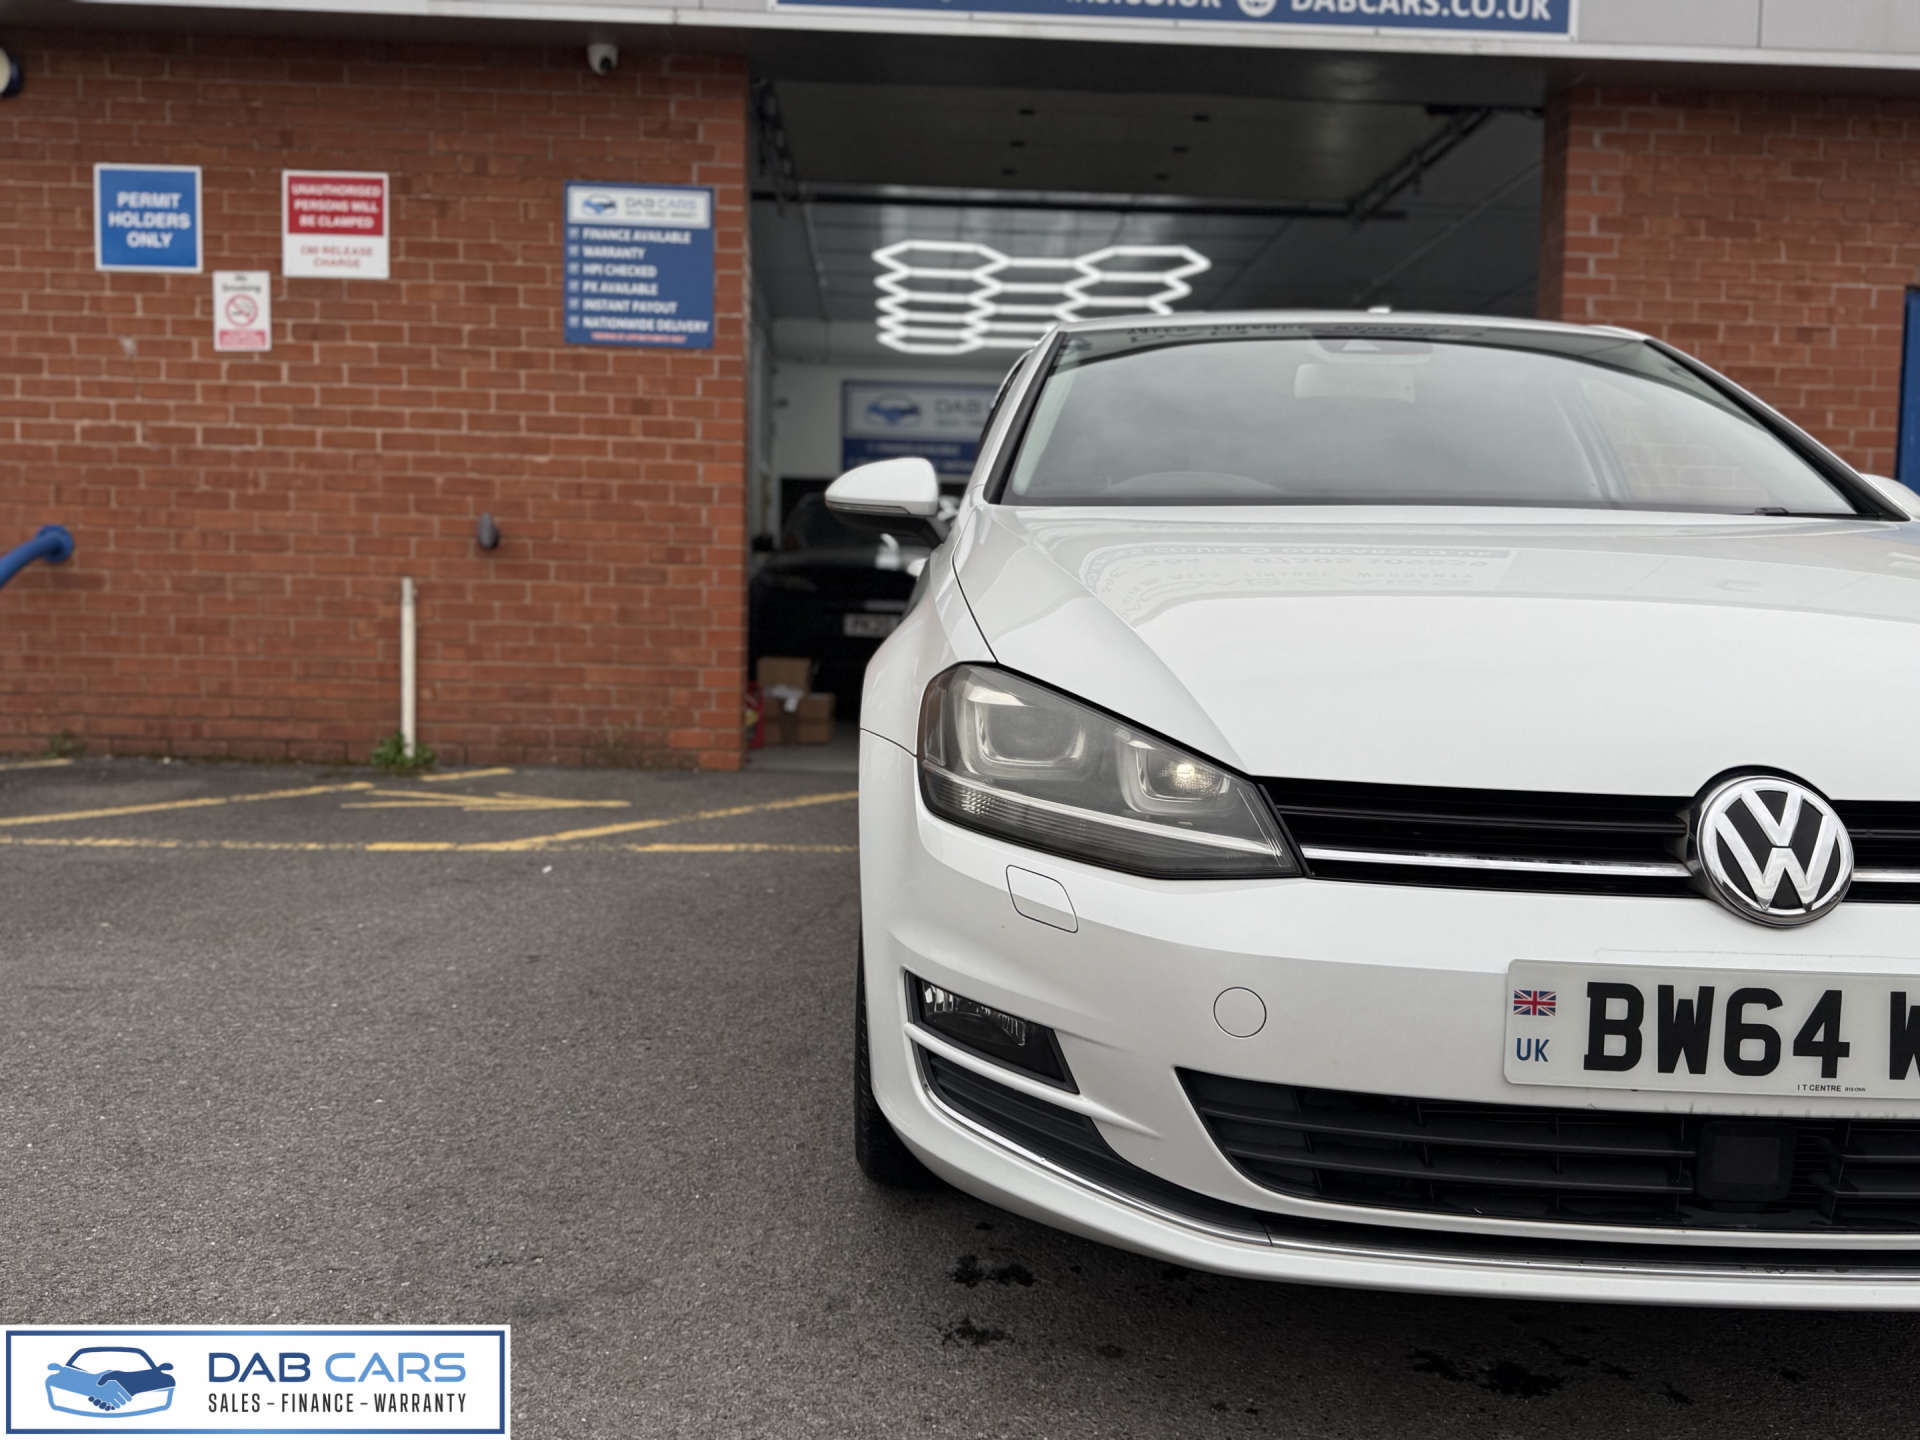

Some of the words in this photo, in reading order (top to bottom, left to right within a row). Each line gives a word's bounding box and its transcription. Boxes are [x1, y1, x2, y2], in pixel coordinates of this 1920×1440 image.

[117, 192, 181, 209] PERMIT
[294, 198, 349, 212] PERSONS
[351, 200, 379, 214] WILL
[107, 211, 190, 230] HOLDERS
[299, 215, 316, 228] BE
[317, 215, 374, 229] CLAMPED
[126, 231, 173, 248] ONLY
[582, 227, 631, 241] FINANCE
[633, 230, 691, 244] AVAILABLE
[582, 245, 646, 260] WARRANTY
[604, 264, 657, 278] CHECKED
[582, 298, 630, 312] INSTANT
[582, 316, 654, 331] NATIONWIDE
[656, 318, 710, 333] DELIVERY
[1583, 981, 1850, 1079] BW64
[1515, 1036, 1550, 1063] UK
[1809, 1084, 1841, 1093] CENTRE
